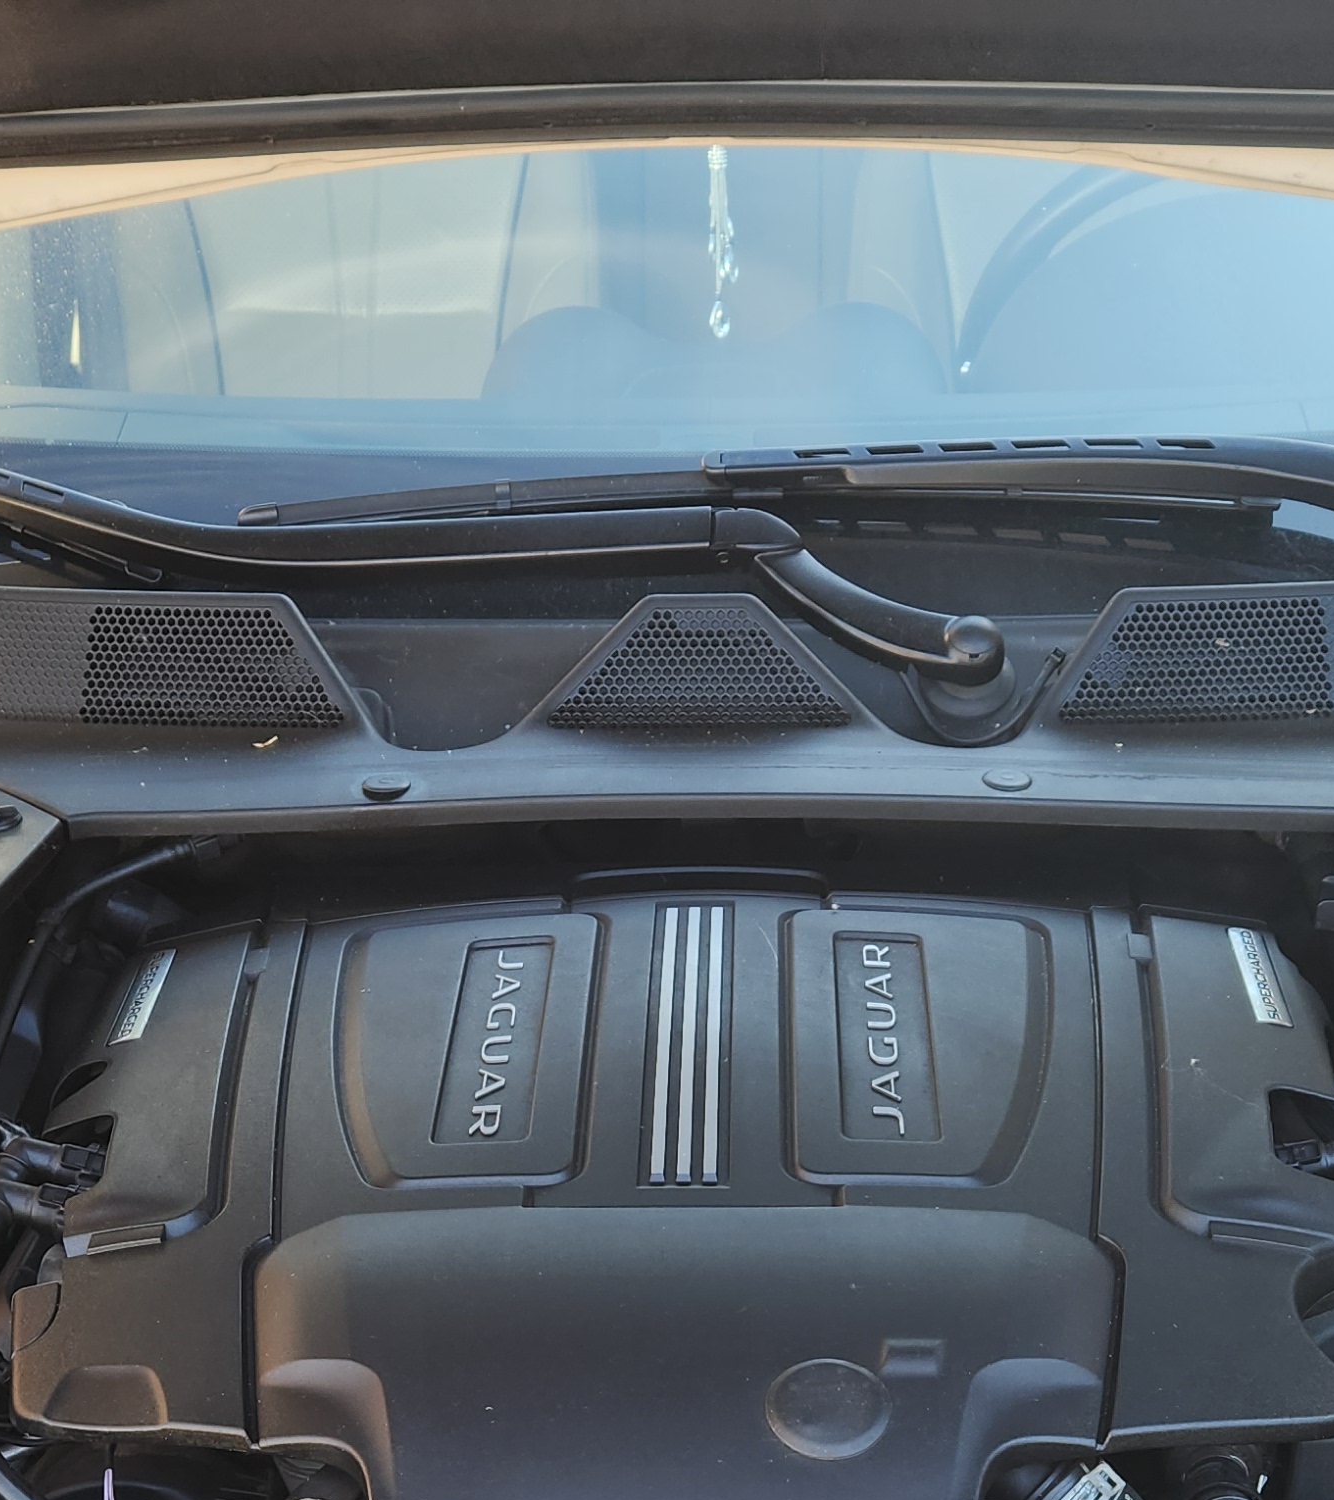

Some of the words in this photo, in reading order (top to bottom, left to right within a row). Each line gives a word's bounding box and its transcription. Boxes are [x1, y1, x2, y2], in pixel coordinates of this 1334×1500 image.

[117, 952, 164, 1038] SUPERCHARGED
[468, 950, 524, 1136] JAGUAR
[862, 943, 905, 1135] JAGUAR
[1240, 930, 1280, 1020] SUPERCHARGED
